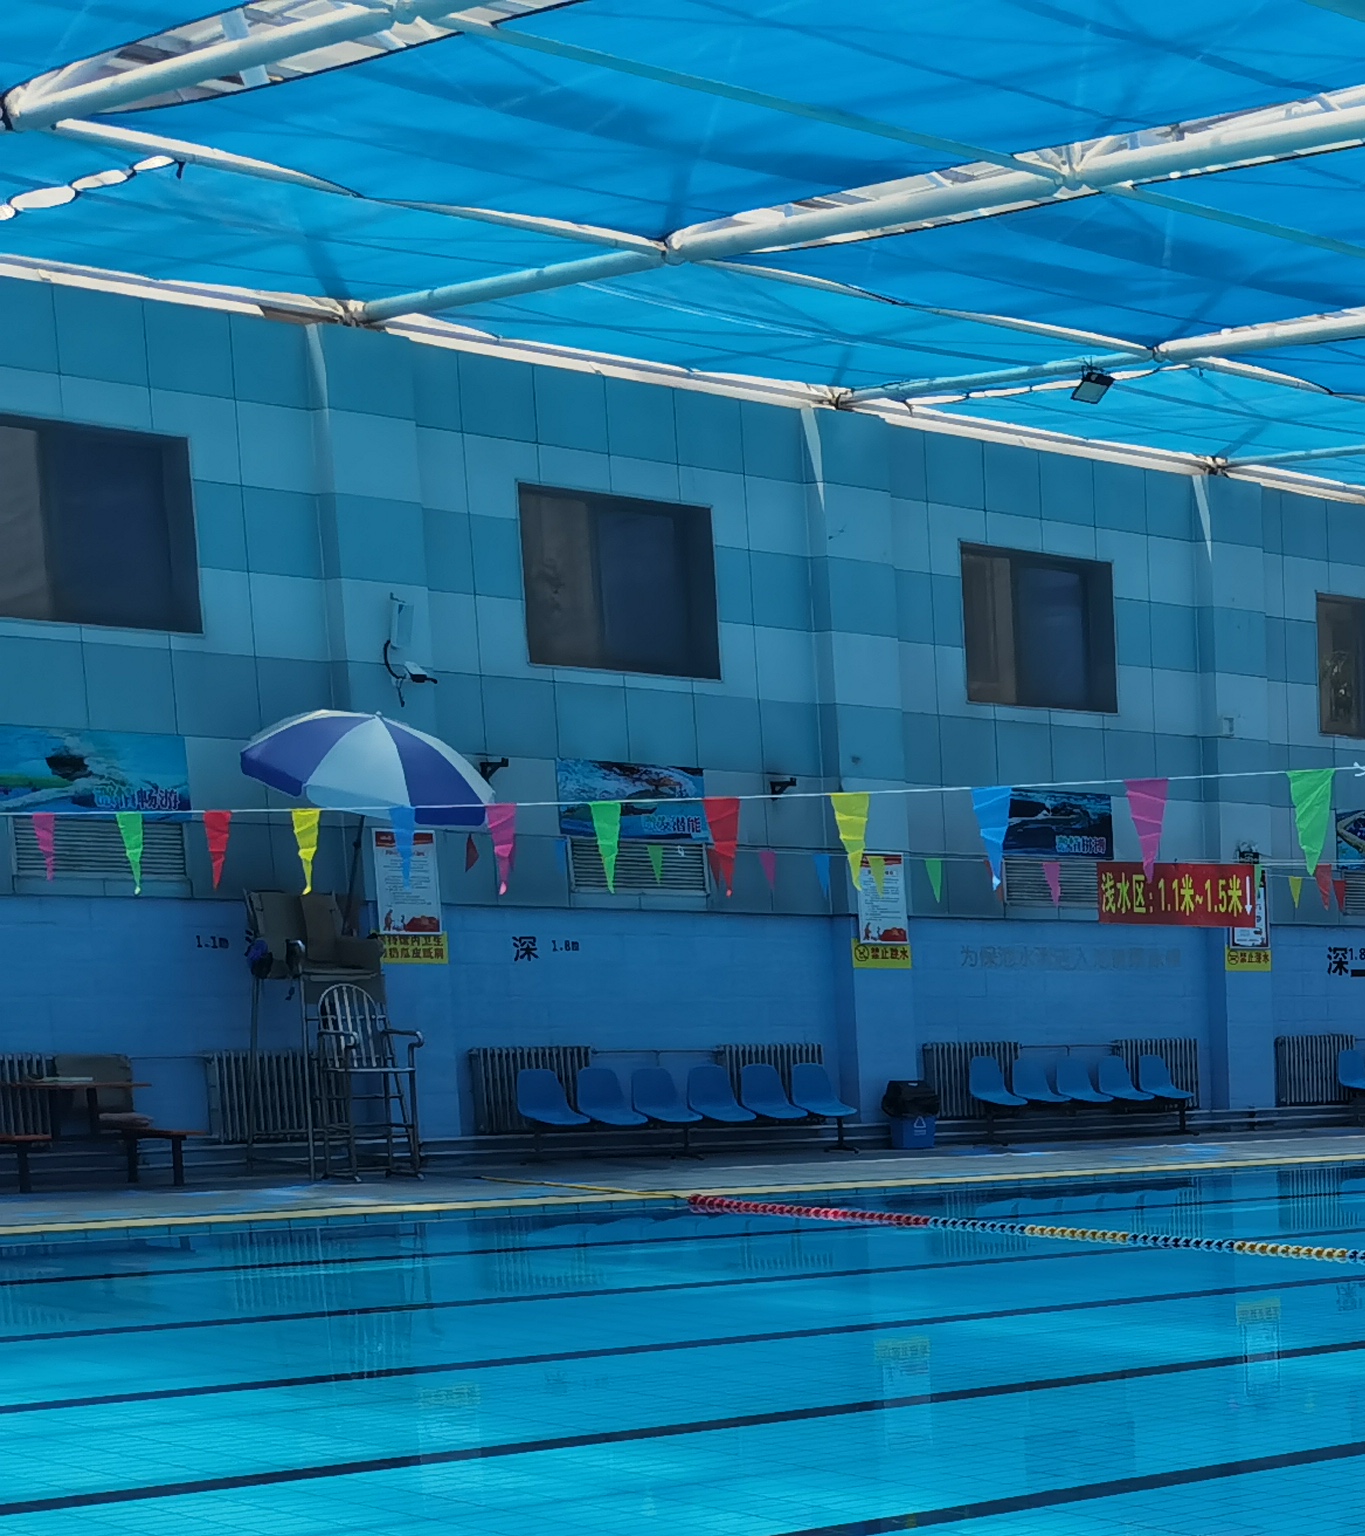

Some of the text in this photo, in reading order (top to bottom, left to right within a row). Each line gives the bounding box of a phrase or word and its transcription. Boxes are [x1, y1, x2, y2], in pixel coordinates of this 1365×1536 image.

[512, 936, 580, 961] 深 1.8m
[1327, 947, 1348, 976] 深
